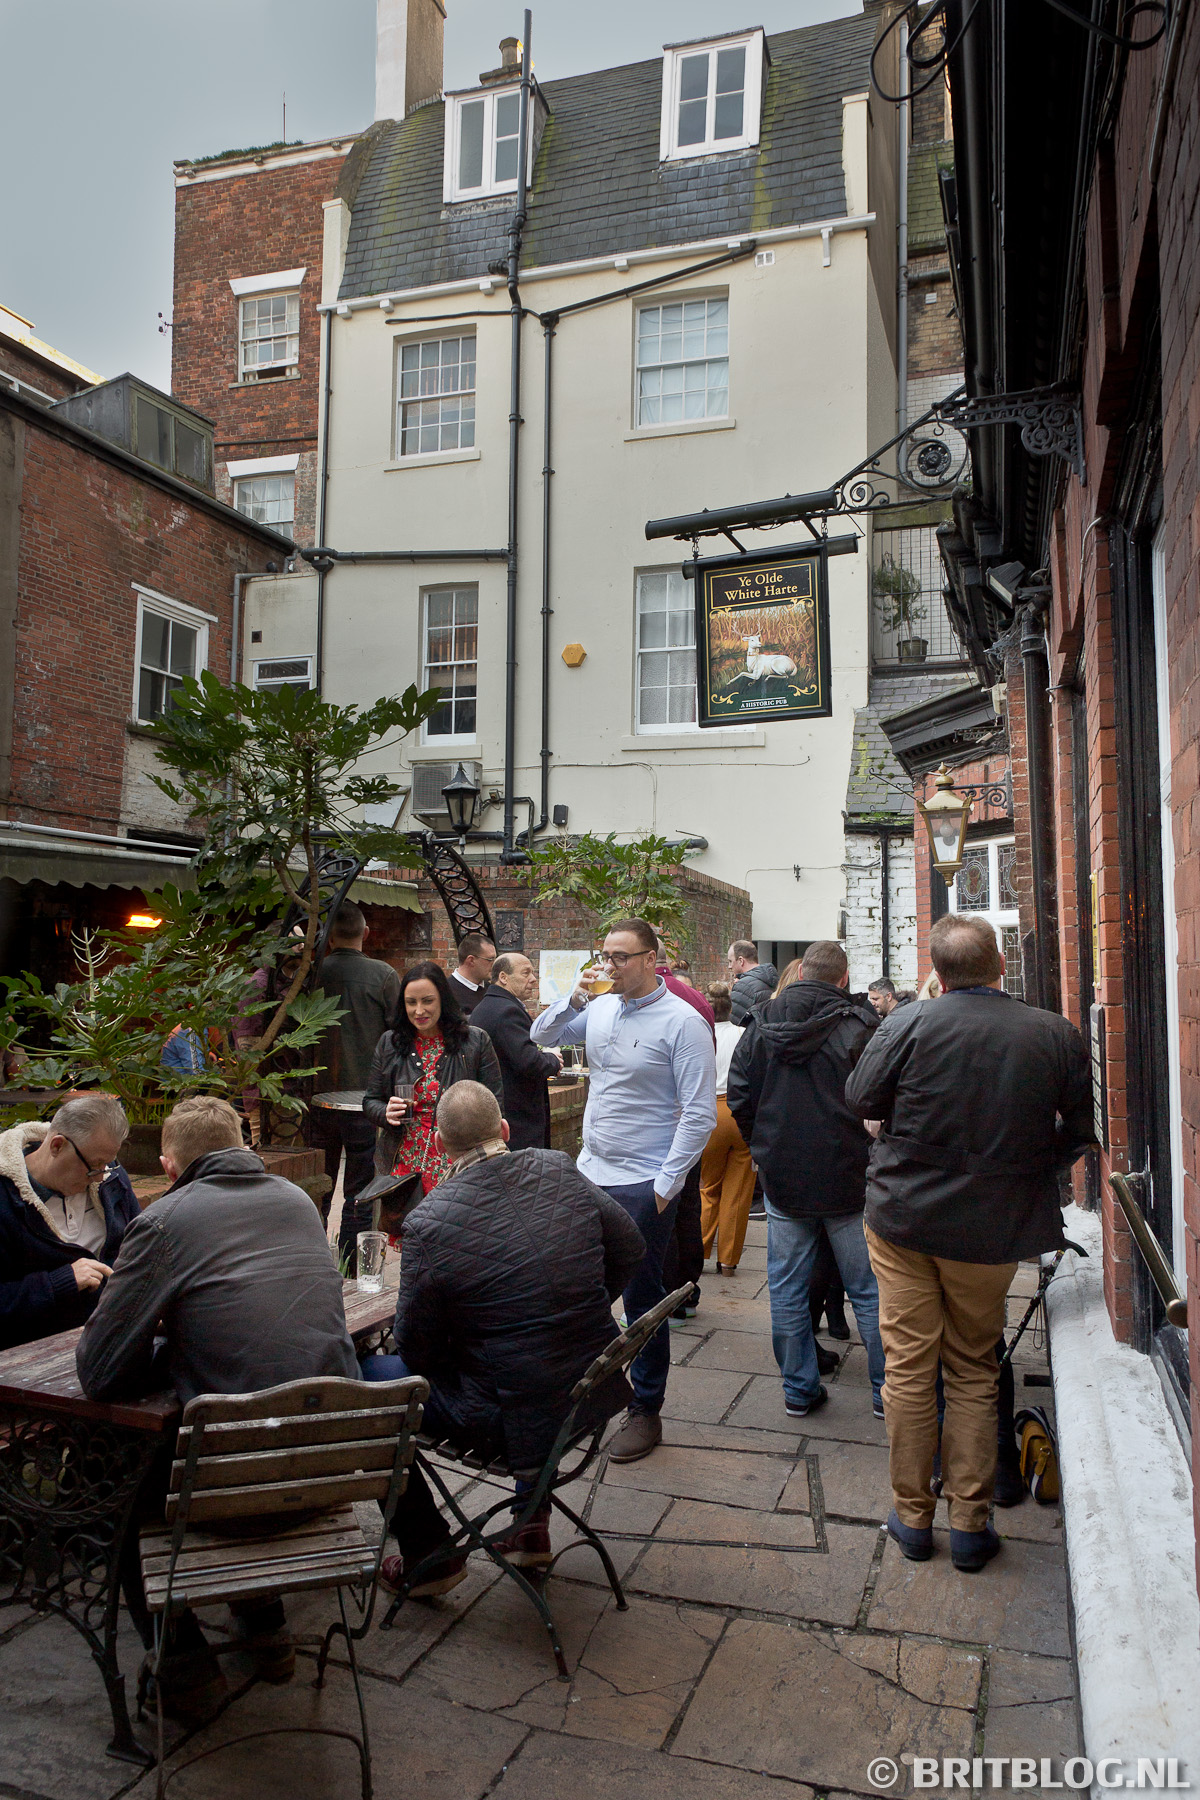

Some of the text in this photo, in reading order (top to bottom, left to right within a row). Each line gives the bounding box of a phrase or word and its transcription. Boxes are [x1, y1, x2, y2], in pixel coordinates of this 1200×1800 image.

[738, 572, 783, 587] Ye Olde
[724, 584, 798, 601] White Harte
